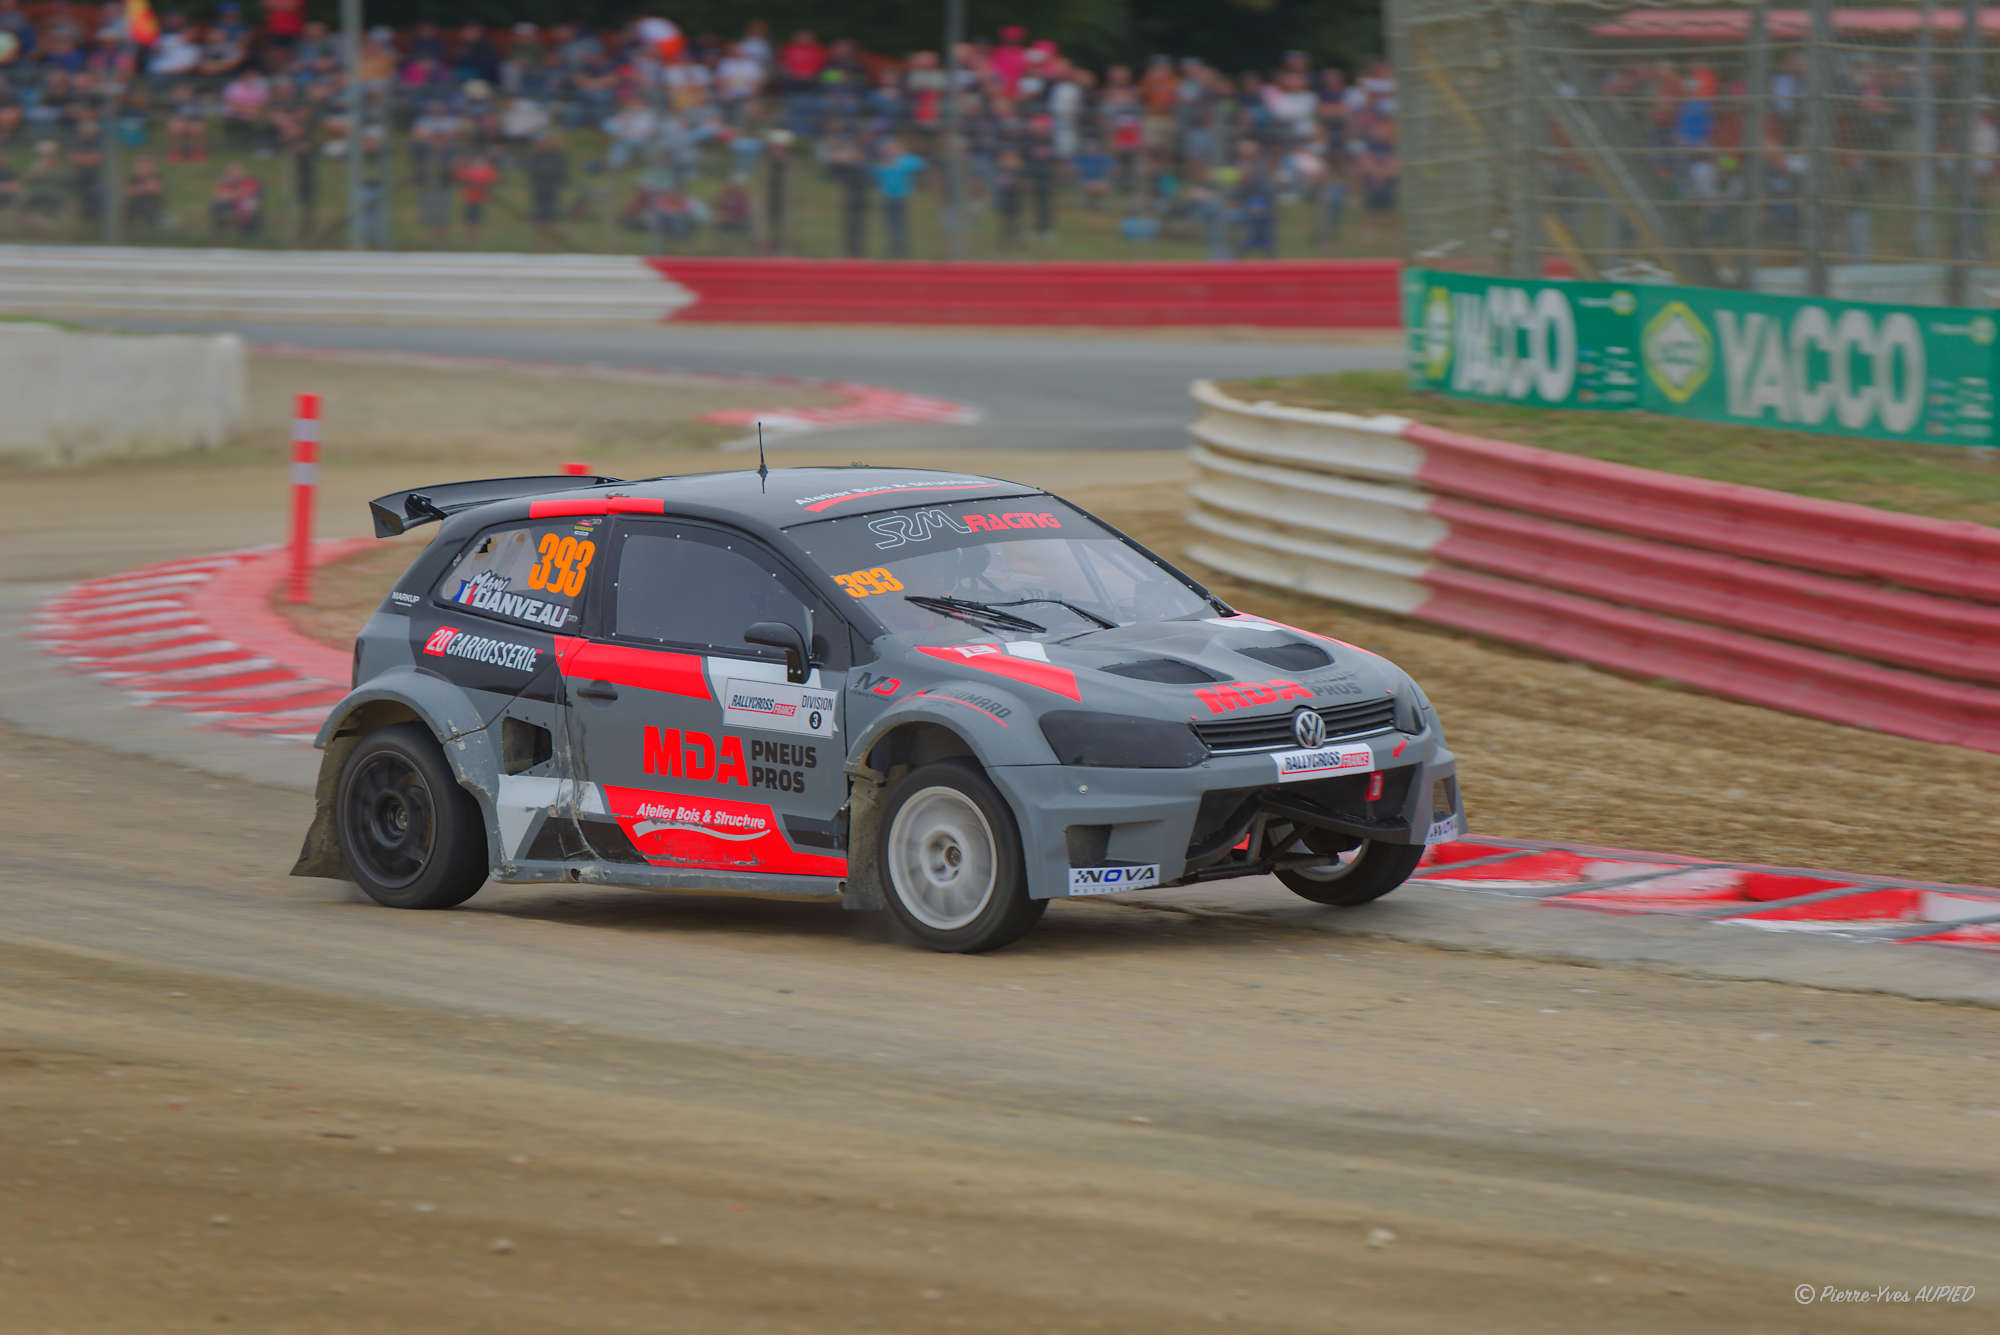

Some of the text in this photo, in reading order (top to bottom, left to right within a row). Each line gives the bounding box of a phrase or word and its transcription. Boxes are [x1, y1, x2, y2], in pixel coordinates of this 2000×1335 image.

[1713, 305, 1926, 433] YACCO
[528, 532, 596, 598] 393
[832, 567, 905, 598] 393
[471, 586, 569, 628] DANVEAU
[445, 632, 537, 673] CARROSSERIE
[731, 693, 775, 711] RALLYCROSS
[801, 694, 834, 712] DIVISION
[1191, 679, 1317, 714] MDA
[643, 725, 750, 787] MDA
[751, 739, 818, 768] PNEUS
[1284, 751, 1341, 771] RALLYCROSS
[751, 766, 806, 793] PROS
[636, 803, 766, 829] Atelier Bois & Structure
